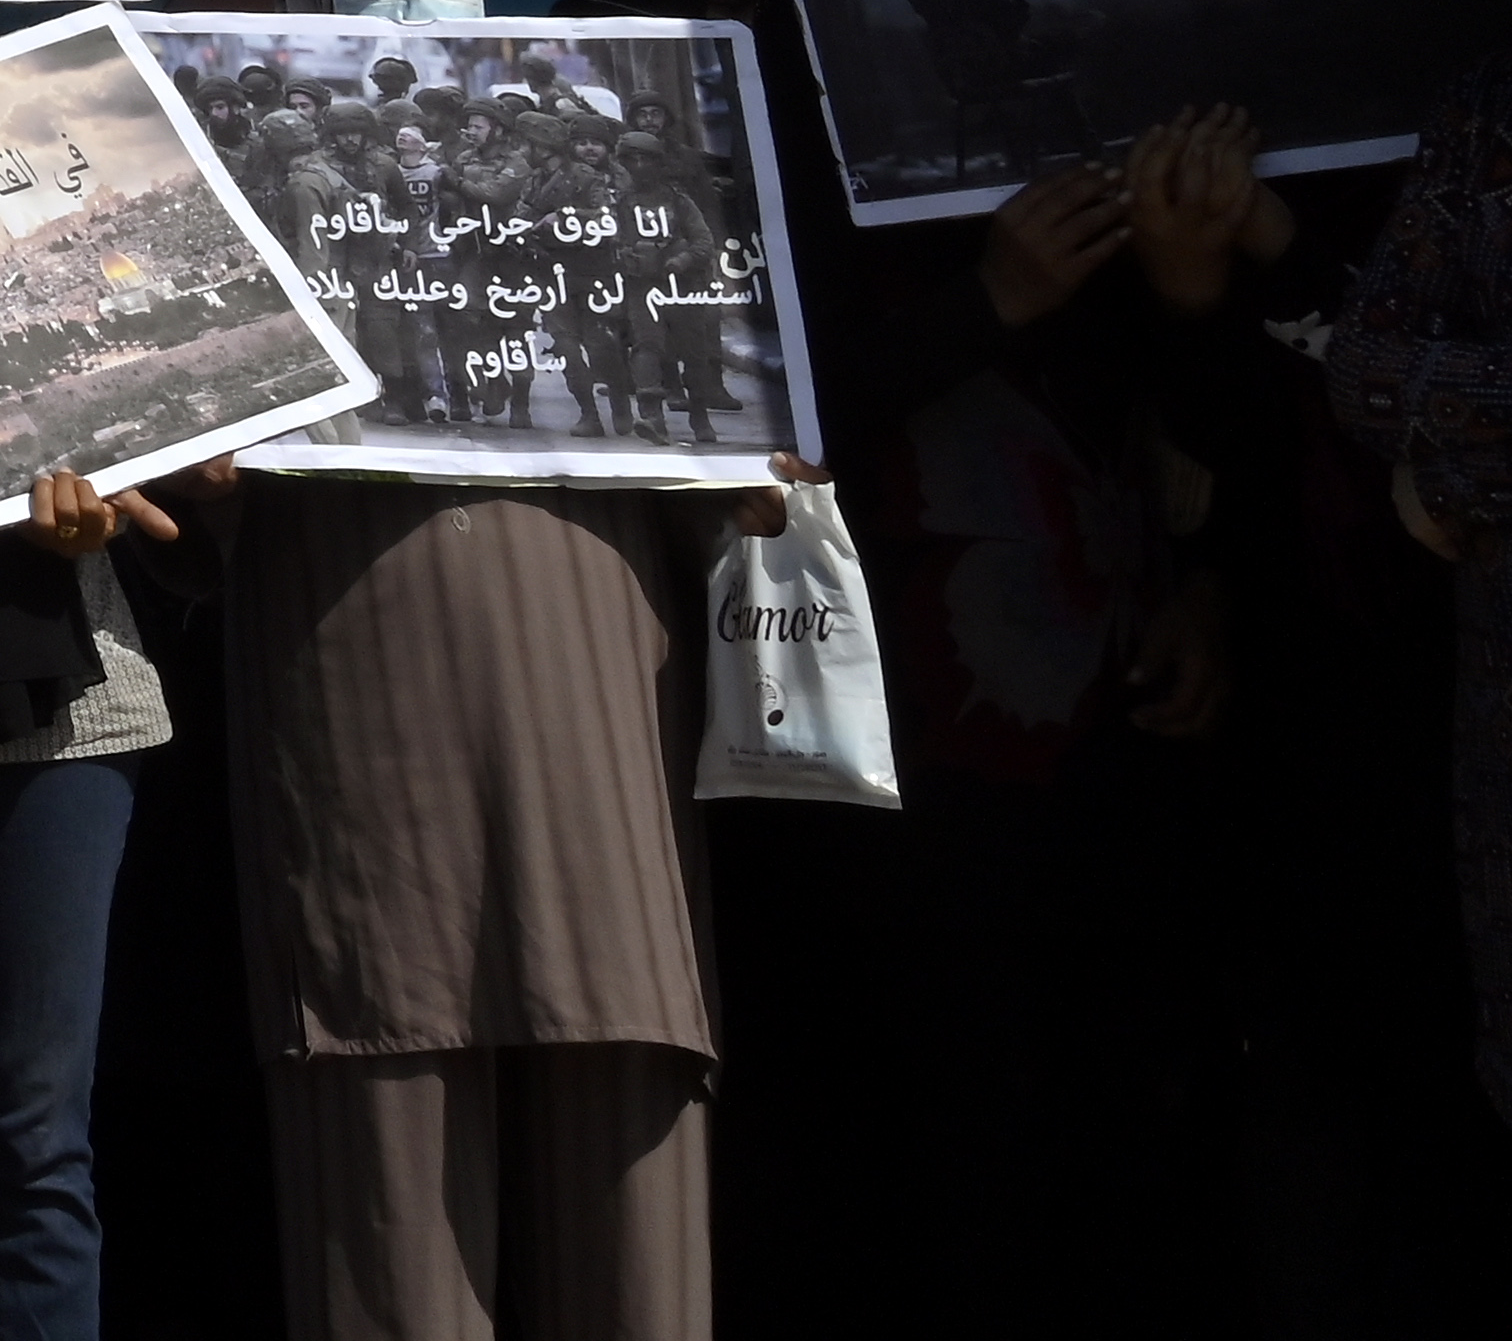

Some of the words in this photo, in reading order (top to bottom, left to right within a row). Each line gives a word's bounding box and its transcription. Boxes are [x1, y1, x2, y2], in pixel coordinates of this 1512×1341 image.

[54, 132, 91, 199] في
[310, 194, 409, 249] سأقاوم
[429, 204, 533, 253] جراحي
[553, 207, 619, 245] فوق
[635, 205, 670, 239] انا
[719, 232, 765, 280] لن
[374, 270, 468, 312] وعليك
[486, 263, 566, 318] أرضخ
[588, 272, 624, 313] لن
[645, 273, 762, 321] استسلم
[465, 331, 566, 386] سأقاوم
